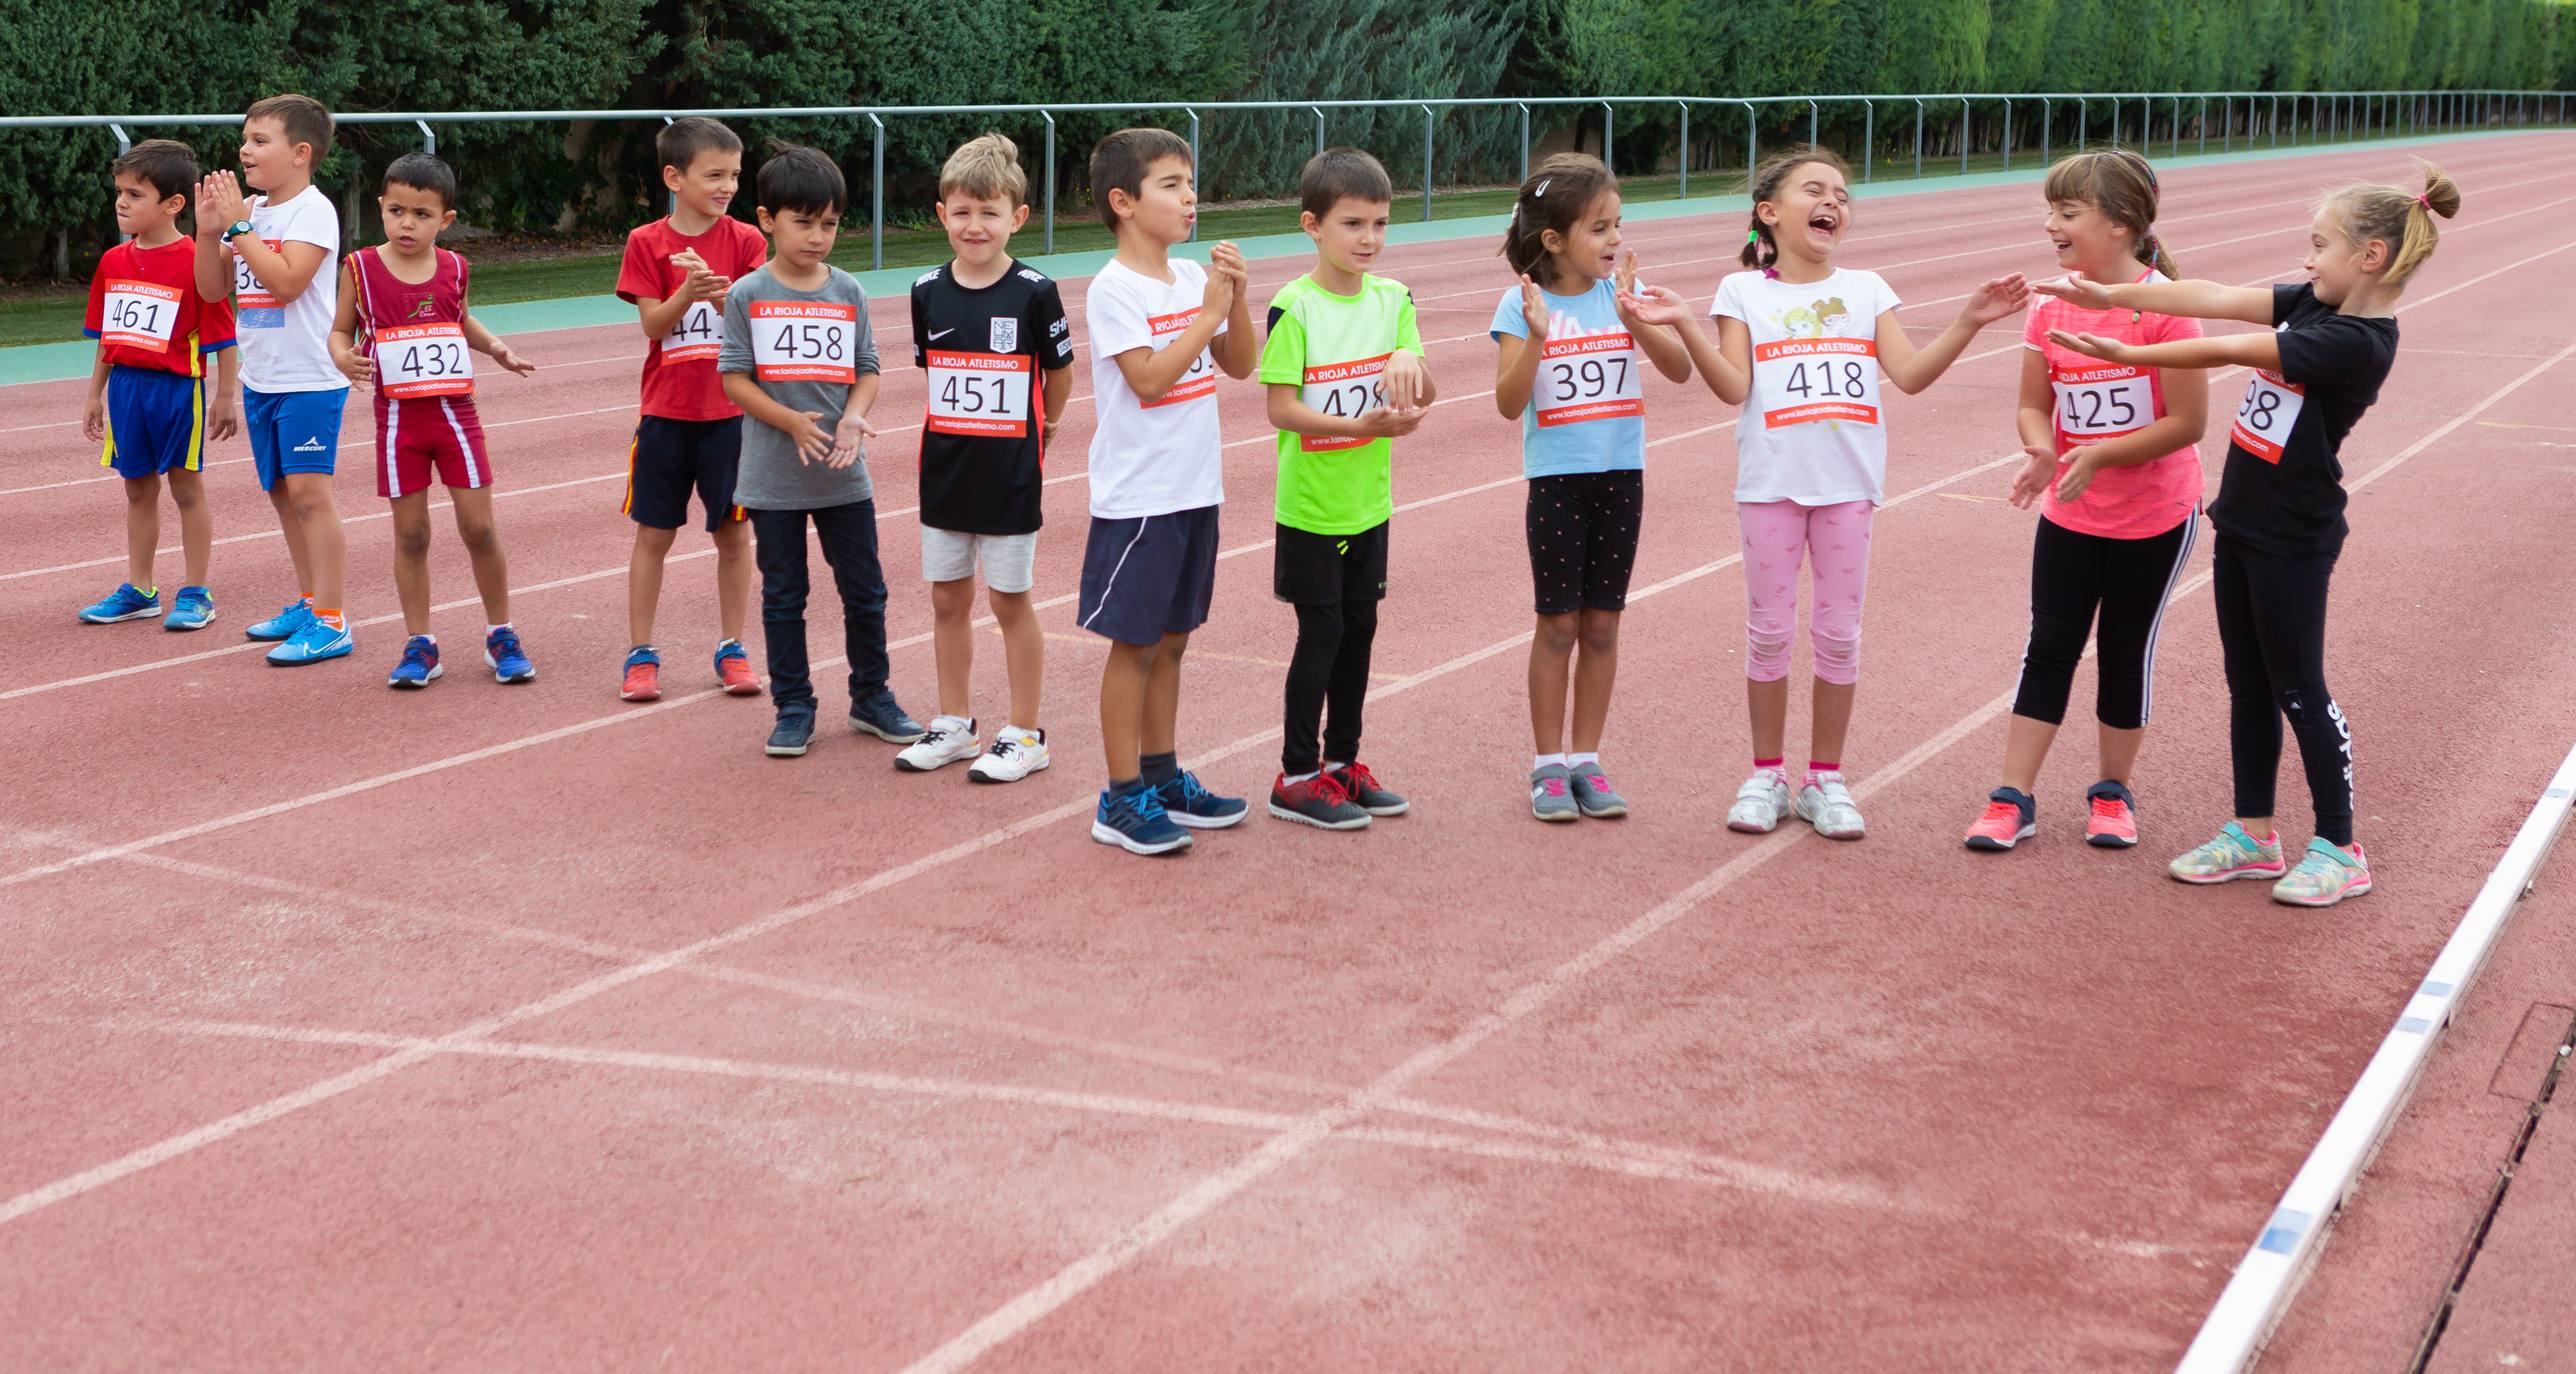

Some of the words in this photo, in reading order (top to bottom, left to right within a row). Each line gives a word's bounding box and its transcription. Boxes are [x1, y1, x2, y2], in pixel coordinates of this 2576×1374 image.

[916, 269, 942, 287] NIKE
[1017, 269, 1046, 283] NIKE
[133, 286, 173, 299] ATLETISMO
[112, 299, 159, 333] 461
[760, 307, 773, 315] LA
[774, 307, 803, 316] RIOJA
[805, 307, 847, 318] ATLETISMO
[386, 331, 397, 340] LA
[398, 329, 425, 338] RIOJA
[427, 327, 459, 336] ATLETISMO
[672, 308, 723, 341] 44
[774, 324, 842, 361] 458
[1549, 343, 1580, 356] RIOJA
[1582, 338, 1630, 351] ATLETISMO
[1767, 348, 1781, 358] LA
[1782, 344, 1815, 355] RIOJA
[1816, 342, 1867, 353] ATLETISMO
[401, 343, 463, 377] 432
[932, 356, 941, 366] LA
[942, 357, 967, 367] RIOJA
[968, 359, 1019, 369] ATLETISMO
[1318, 368, 1348, 380] RIOJA
[1350, 359, 1388, 374] ATLETISM
[1553, 357, 1628, 402] 397
[1786, 361, 1864, 399] 418
[2082, 367, 2135, 381] ATLETISMO
[941, 376, 1010, 414] 451
[1323, 380, 1383, 419] 428
[2067, 387, 2135, 429] 425
